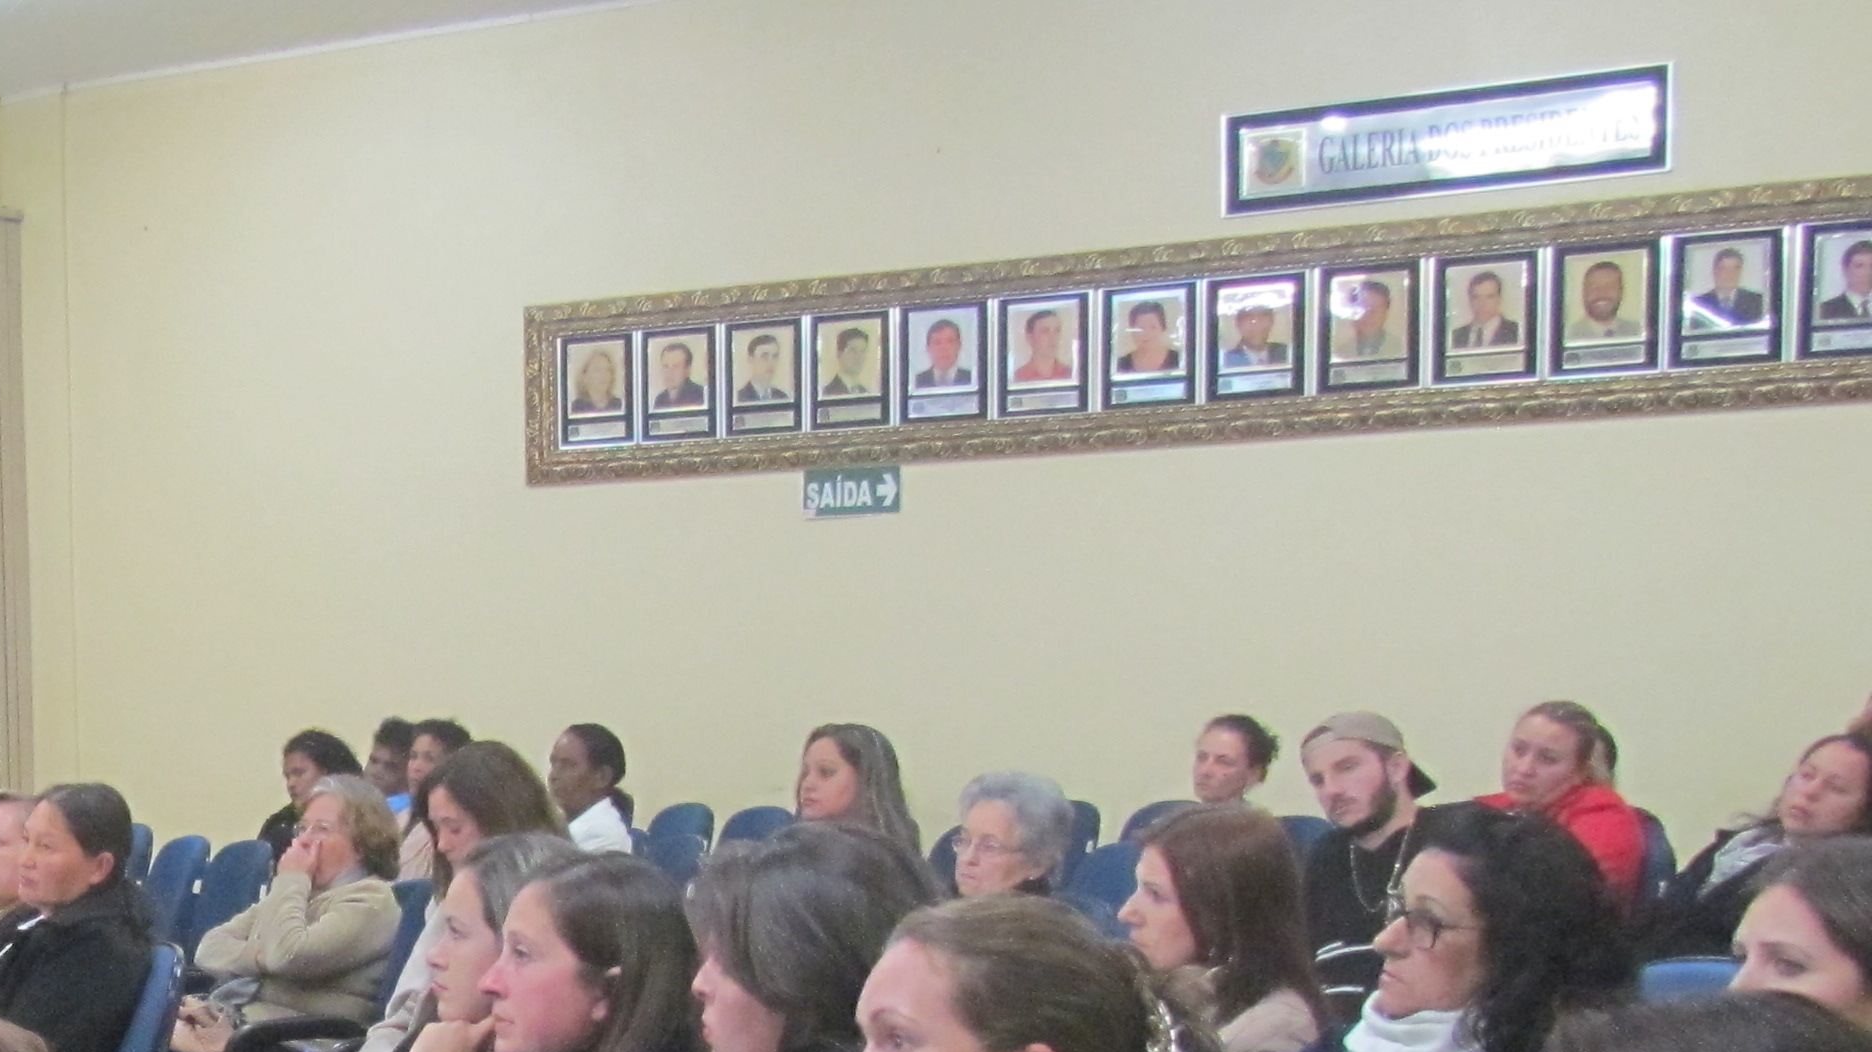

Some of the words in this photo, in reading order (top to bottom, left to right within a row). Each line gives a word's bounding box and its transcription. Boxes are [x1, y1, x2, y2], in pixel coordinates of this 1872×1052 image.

[1318, 127, 1421, 174] GALERIA
[1428, 121, 1473, 161] DOS
[1480, 104, 1641, 157] PRESIDEES
[807, 475, 872, 509] SAÍDA
